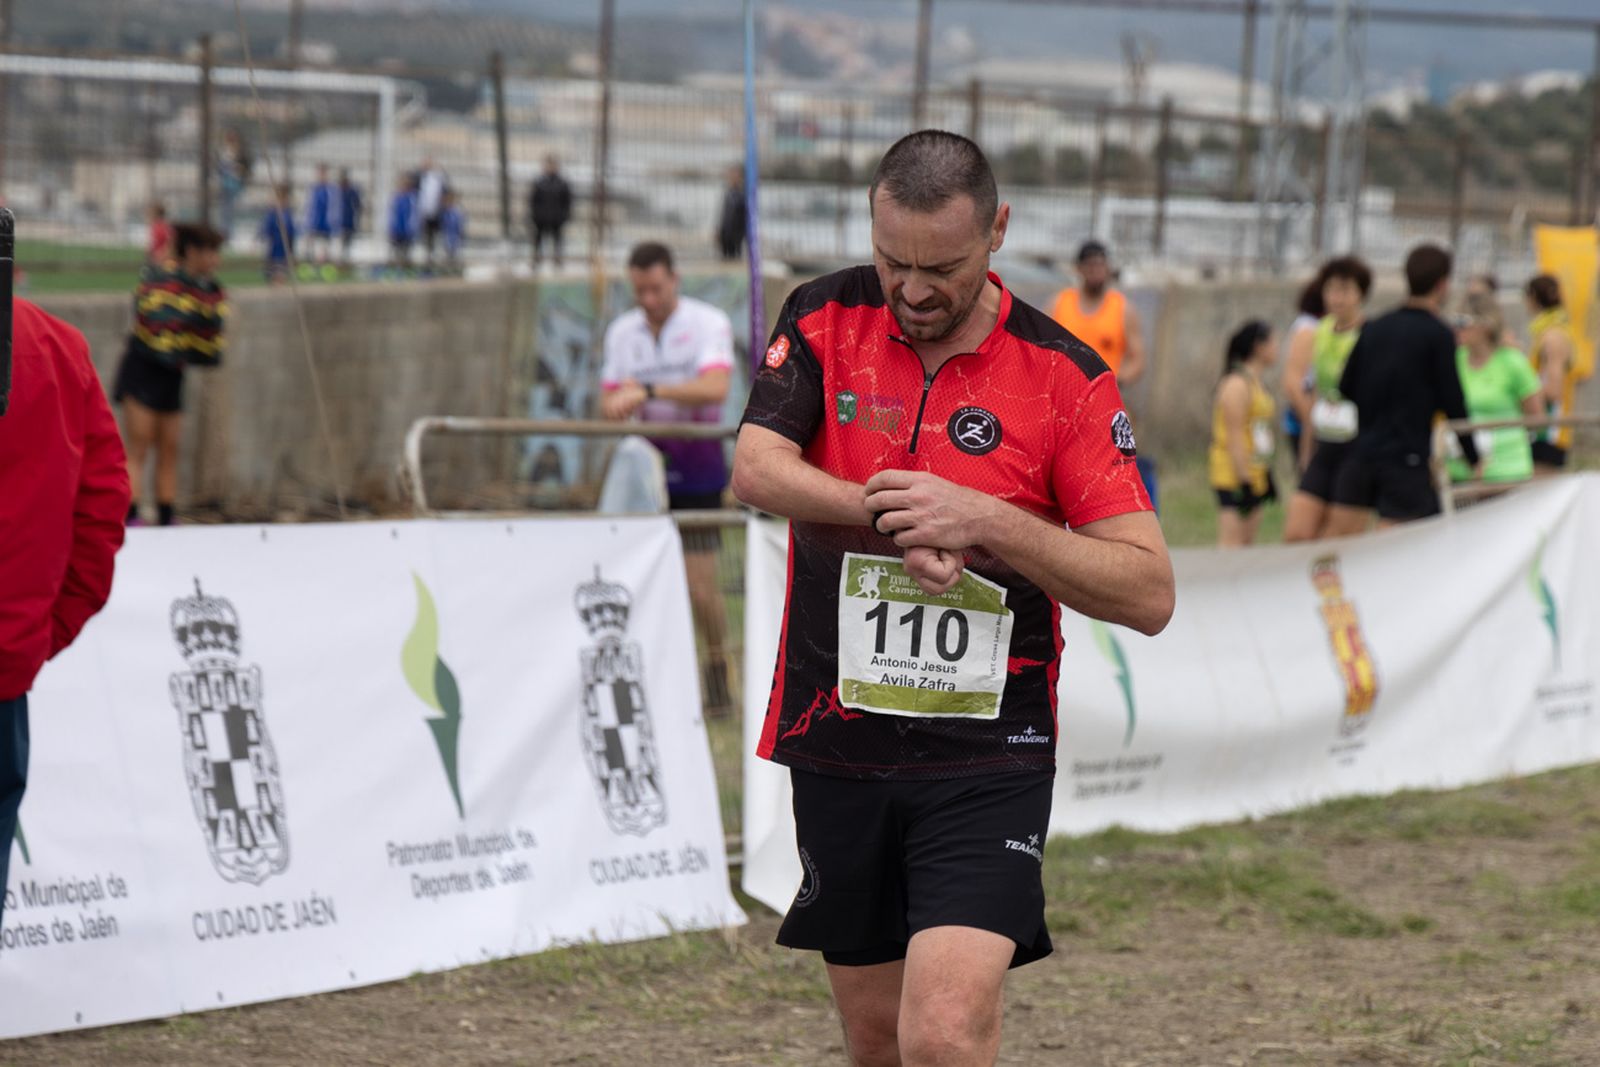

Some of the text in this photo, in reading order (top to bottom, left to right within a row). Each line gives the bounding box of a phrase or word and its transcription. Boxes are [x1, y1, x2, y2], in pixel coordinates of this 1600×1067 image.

[888, 584, 923, 597] Campo
[865, 601, 969, 663] 110
[870, 655, 958, 675] Antonio Jesus
[880, 673, 957, 692] Avila Zafra
[386, 838, 454, 869] Patronato
[455, 831, 516, 862] Municipal
[589, 850, 651, 887] CIUDAD
[648, 848, 675, 878] DE
[20, 873, 106, 910] Municipal
[106, 871, 129, 899] de
[411, 872, 474, 902] Deportes
[475, 866, 496, 891] de
[51, 915, 75, 943] de
[79, 908, 120, 942] Jaén
[191, 889, 338, 941] CIUDAD DE JAÉN
